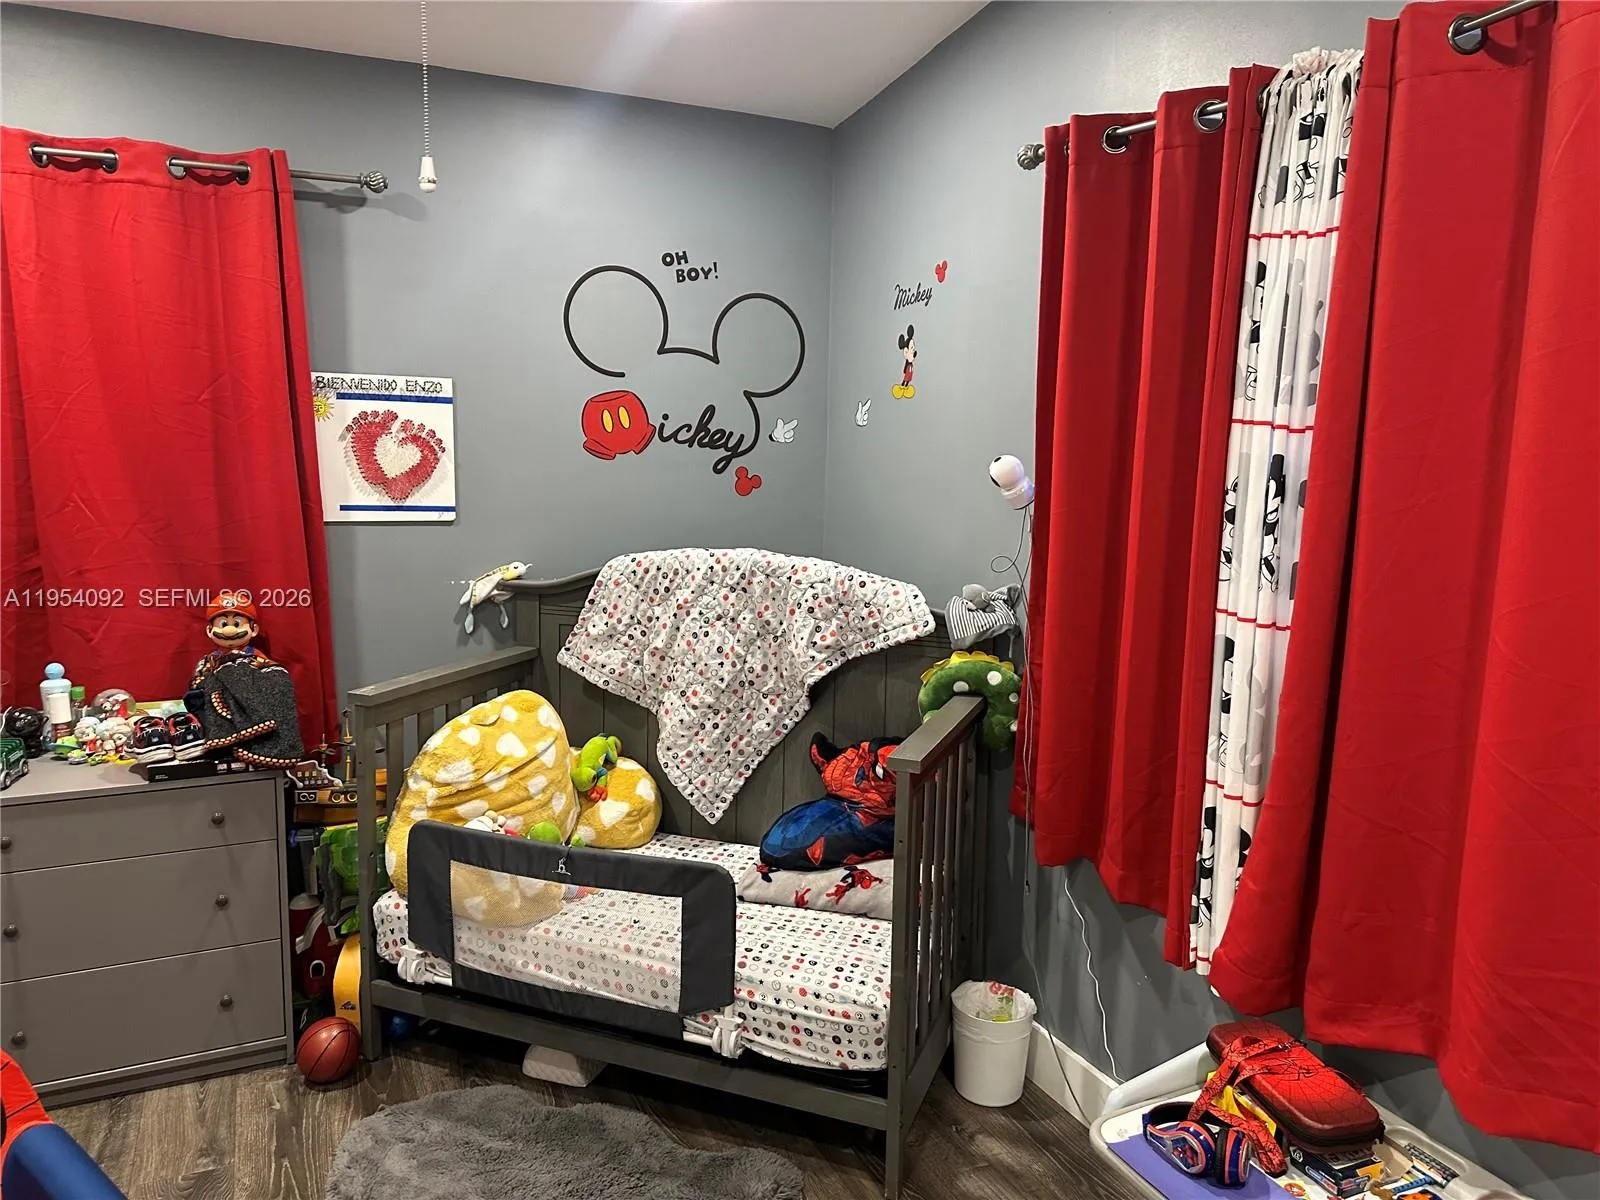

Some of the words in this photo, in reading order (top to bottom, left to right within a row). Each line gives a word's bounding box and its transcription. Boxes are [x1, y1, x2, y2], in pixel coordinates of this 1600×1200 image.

[661, 250, 689, 268] OH
[675, 262, 720, 284] BOY!
[894, 282, 933, 311] Mickey
[314, 375, 398, 392] BIENVENIDO
[405, 378, 443, 394] ENZO
